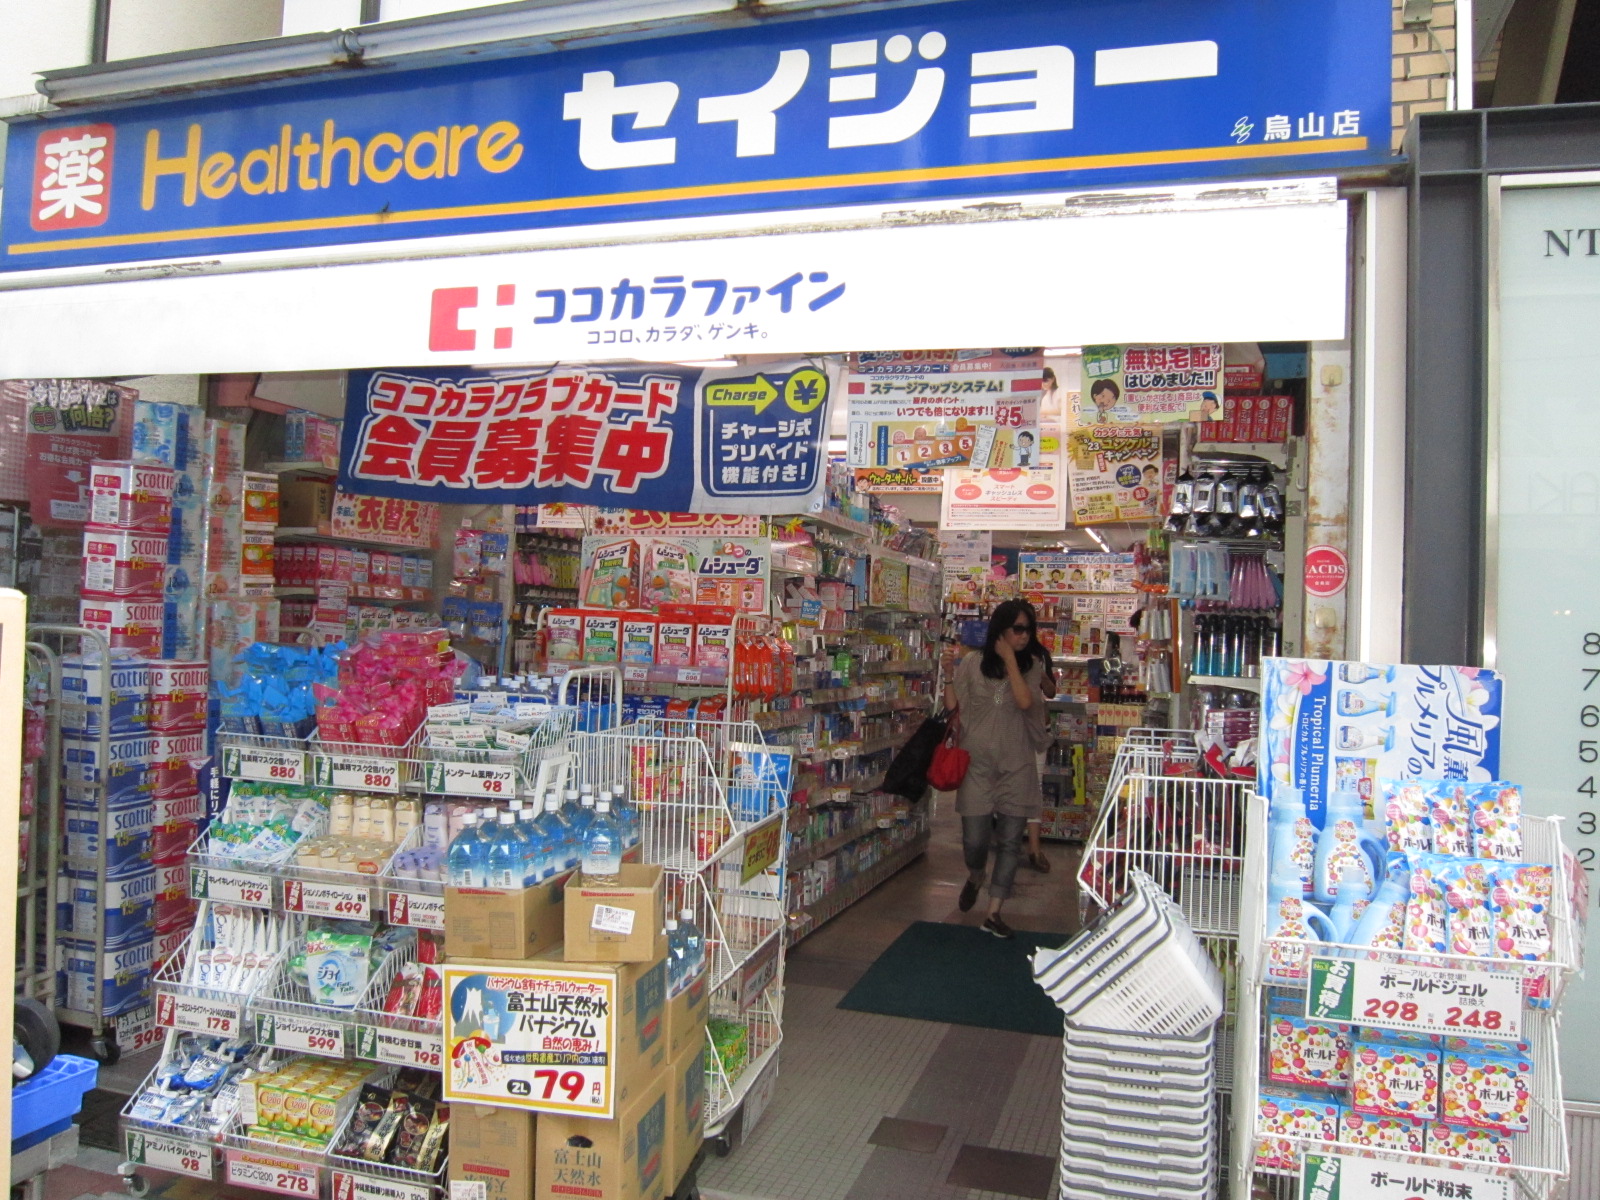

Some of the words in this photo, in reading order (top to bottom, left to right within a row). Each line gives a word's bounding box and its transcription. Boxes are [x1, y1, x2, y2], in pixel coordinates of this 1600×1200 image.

[38, 135, 105, 222] 薬
[141, 118, 525, 211] Healthcare
[563, 31, 1218, 171] セイジョー
[533, 271, 847, 325] ココカラファイン
[1125, 347, 1211, 371] 無料宅配
[372, 376, 676, 418] ココカラクラブカード
[712, 387, 769, 403] Charge
[720, 418, 813, 440] チャージ式
[359, 416, 673, 489] 会員募集中
[720, 441, 810, 463] プリペイド
[698, 556, 764, 575] ムシューダ
[1583, 632, 1600, 655] 8
[1581, 668, 1600, 690] 7
[1309, 696, 1327, 750] Tropical
[1580, 705, 1599, 727] 6
[1579, 740, 1598, 763] 5
[269, 766, 296, 778] 880
[364, 774, 391, 787] 880
[1309, 753, 1325, 812] Plumeria
[482, 780, 503, 792] 98
[1577, 776, 1597, 798] 4
[1577, 812, 1596, 834] 3
[240, 888, 263, 902] 129
[334, 901, 363, 914] 499
[1379, 974, 1488, 998] ボールドジェル
[507, 991, 609, 1019] 富士山天然水
[1363, 998, 1419, 1022] 298
[1444, 1007, 1503, 1030] 248
[206, 1016, 231, 1032] 178
[518, 1014, 597, 1038] バナジウム
[133, 1026, 164, 1050] 398
[307, 1035, 336, 1051] 599
[413, 1051, 441, 1066] 198
[1303, 1047, 1337, 1060] ボールド
[511, 1082, 528, 1093] 2L
[534, 1069, 585, 1102] 79
[592, 1082, 601, 1096] 円
[1389, 1078, 1424, 1091] ボールド
[1479, 1089, 1515, 1102] ボールド
[181, 1157, 200, 1171] 98
[553, 1148, 602, 1169] 富士山
[276, 1173, 309, 1192] 278
[553, 1168, 602, 1186] 天然水
[1370, 1171, 1474, 1200] ボールド粉末
